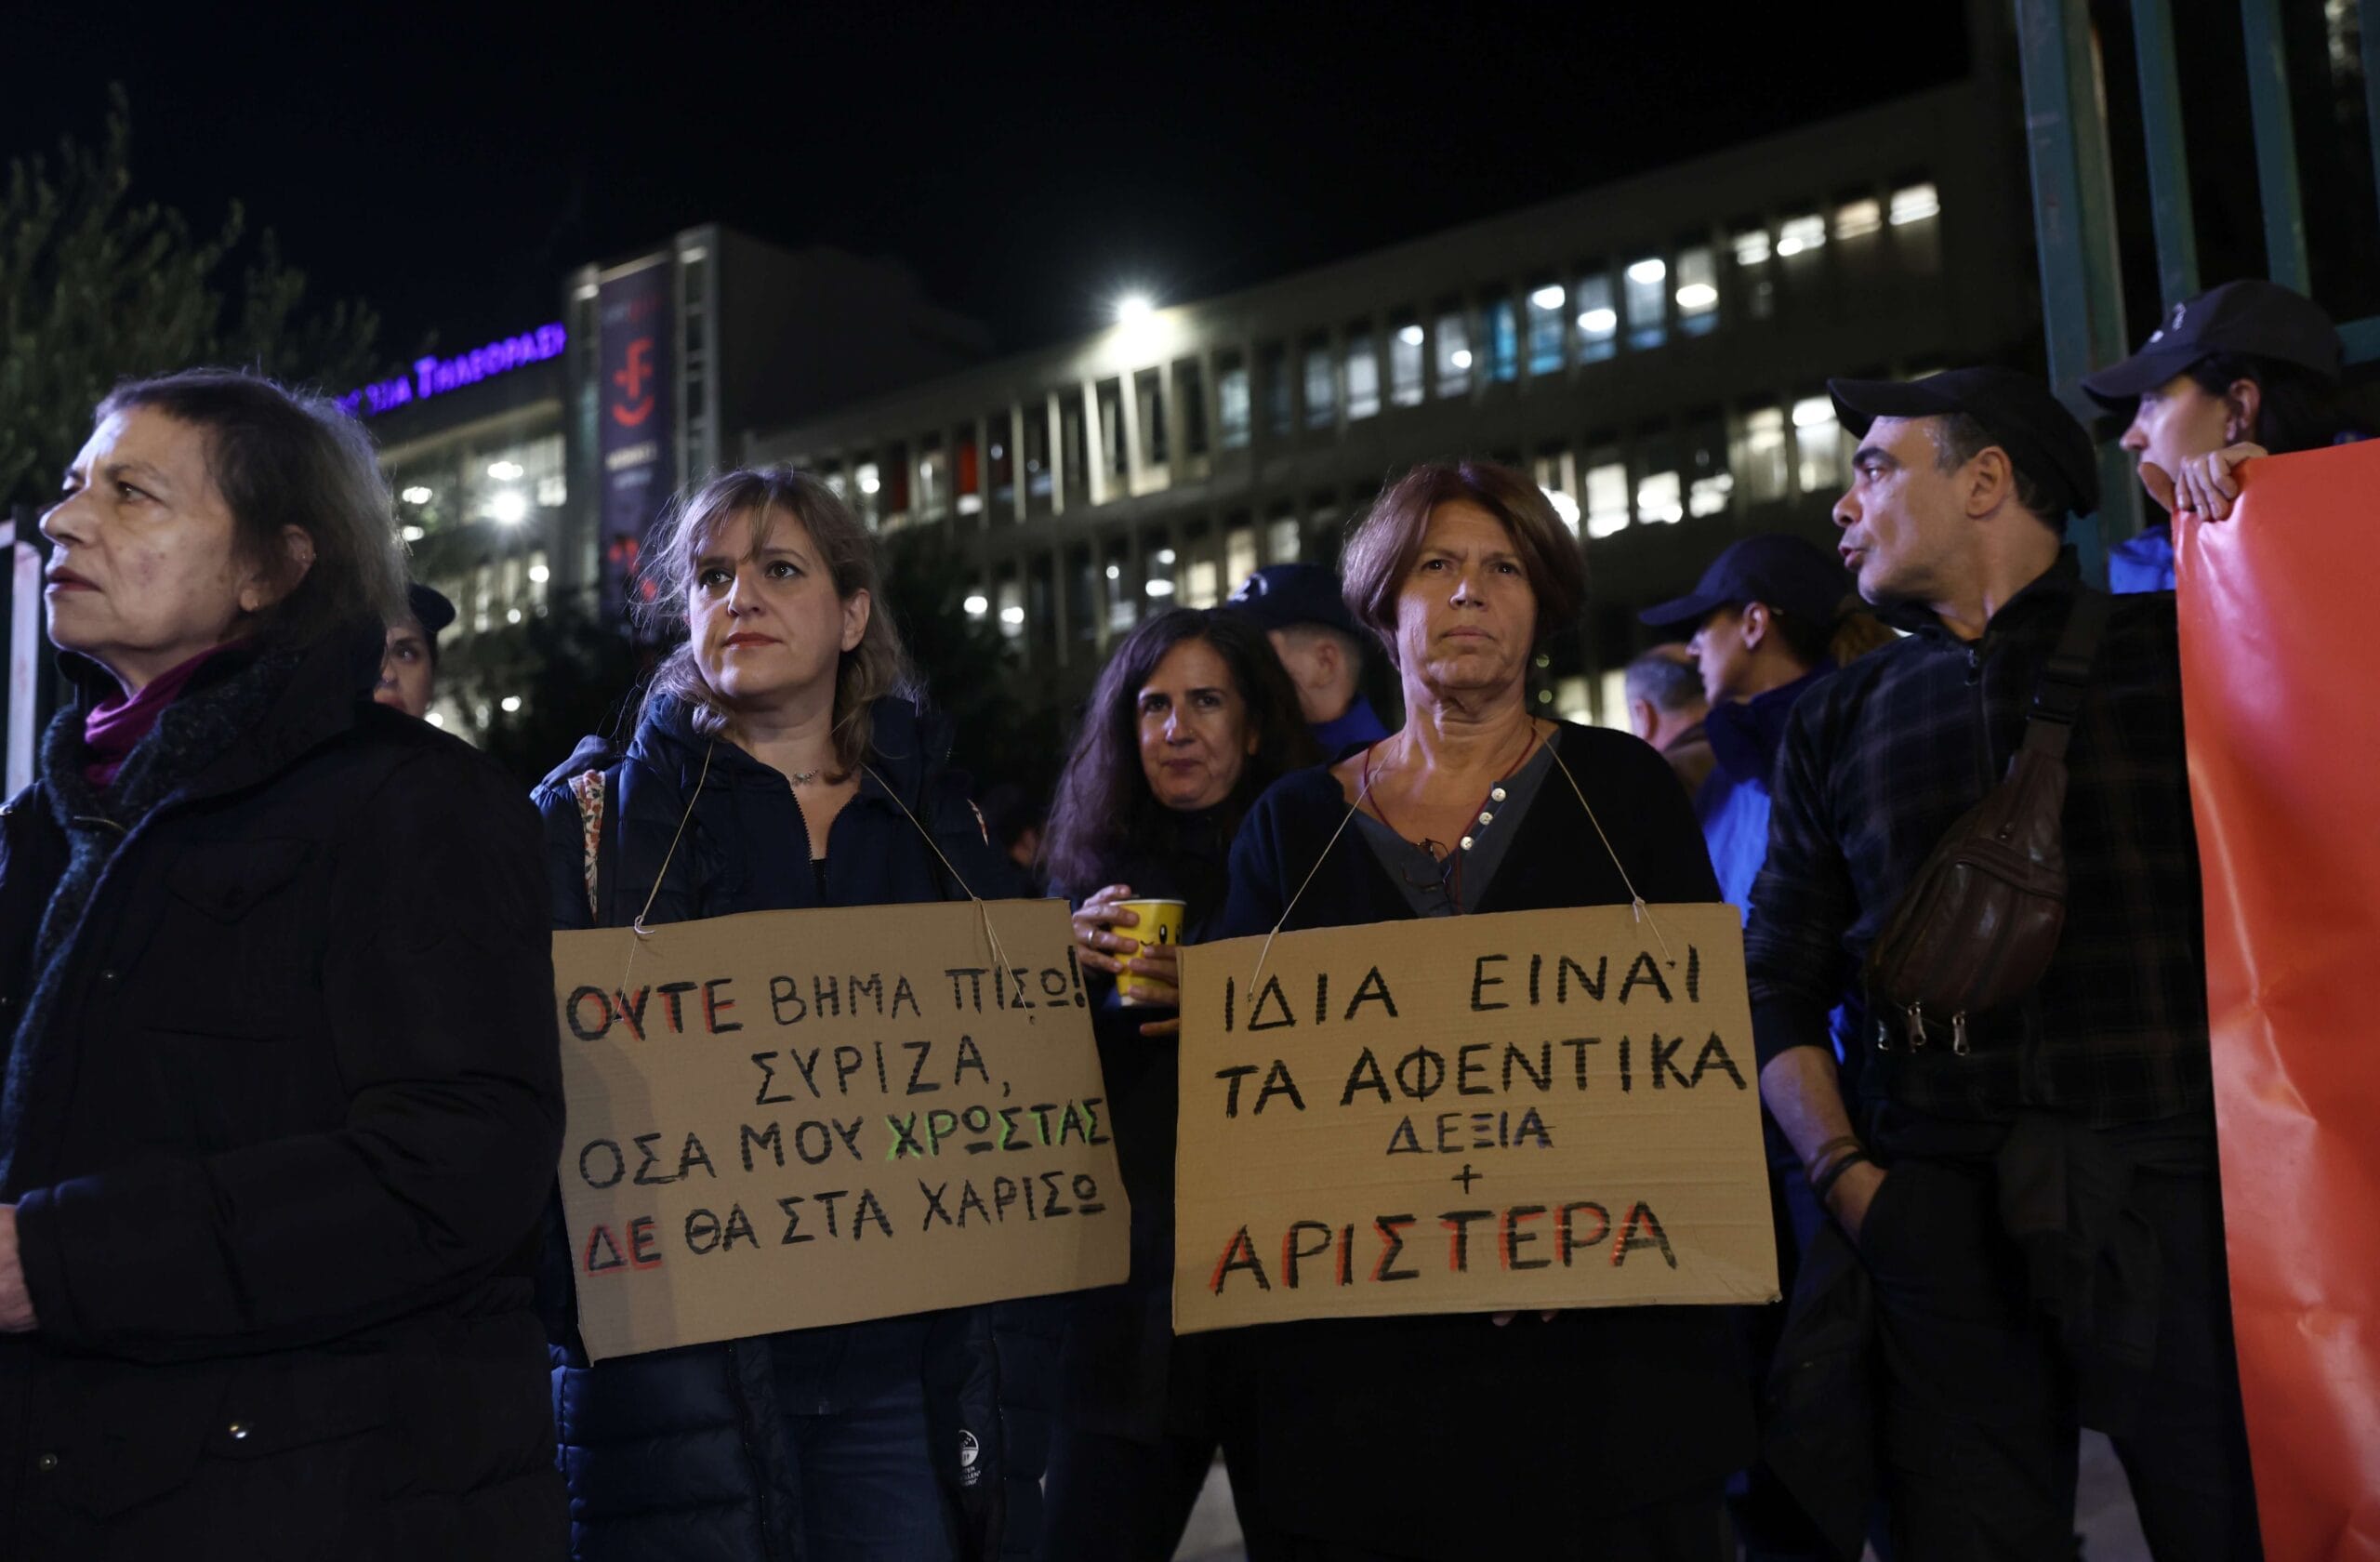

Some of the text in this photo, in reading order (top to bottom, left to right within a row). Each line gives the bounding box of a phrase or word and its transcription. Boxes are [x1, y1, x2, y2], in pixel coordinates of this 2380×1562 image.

[566, 945, 1087, 1040] ΟΥΤΕ ΒΗΜΑ ΠΙΣΩ!
[1224, 943, 1699, 1031] ΙΔΙΑ ΕΙΝΑΙ
[751, 1035, 1012, 1105] ΣΥΡΙΖΑ,
[1215, 1031, 1748, 1119] ΤΑ ΑΦΕΝΤΙΚΑ
[579, 1098, 1111, 1189] ΟΣΑ ΜΟΥ ΧΡΩΣΤΑΣ
[1386, 1106, 1556, 1156] ΔΕΞΙΑ
[582, 1171, 1107, 1277] ΔΕ ΘΑ ΣΤΑ ΧΑΡΙΣΩ
[1209, 1201, 1678, 1296] ΑΡΙΣΤΕΡΑ
